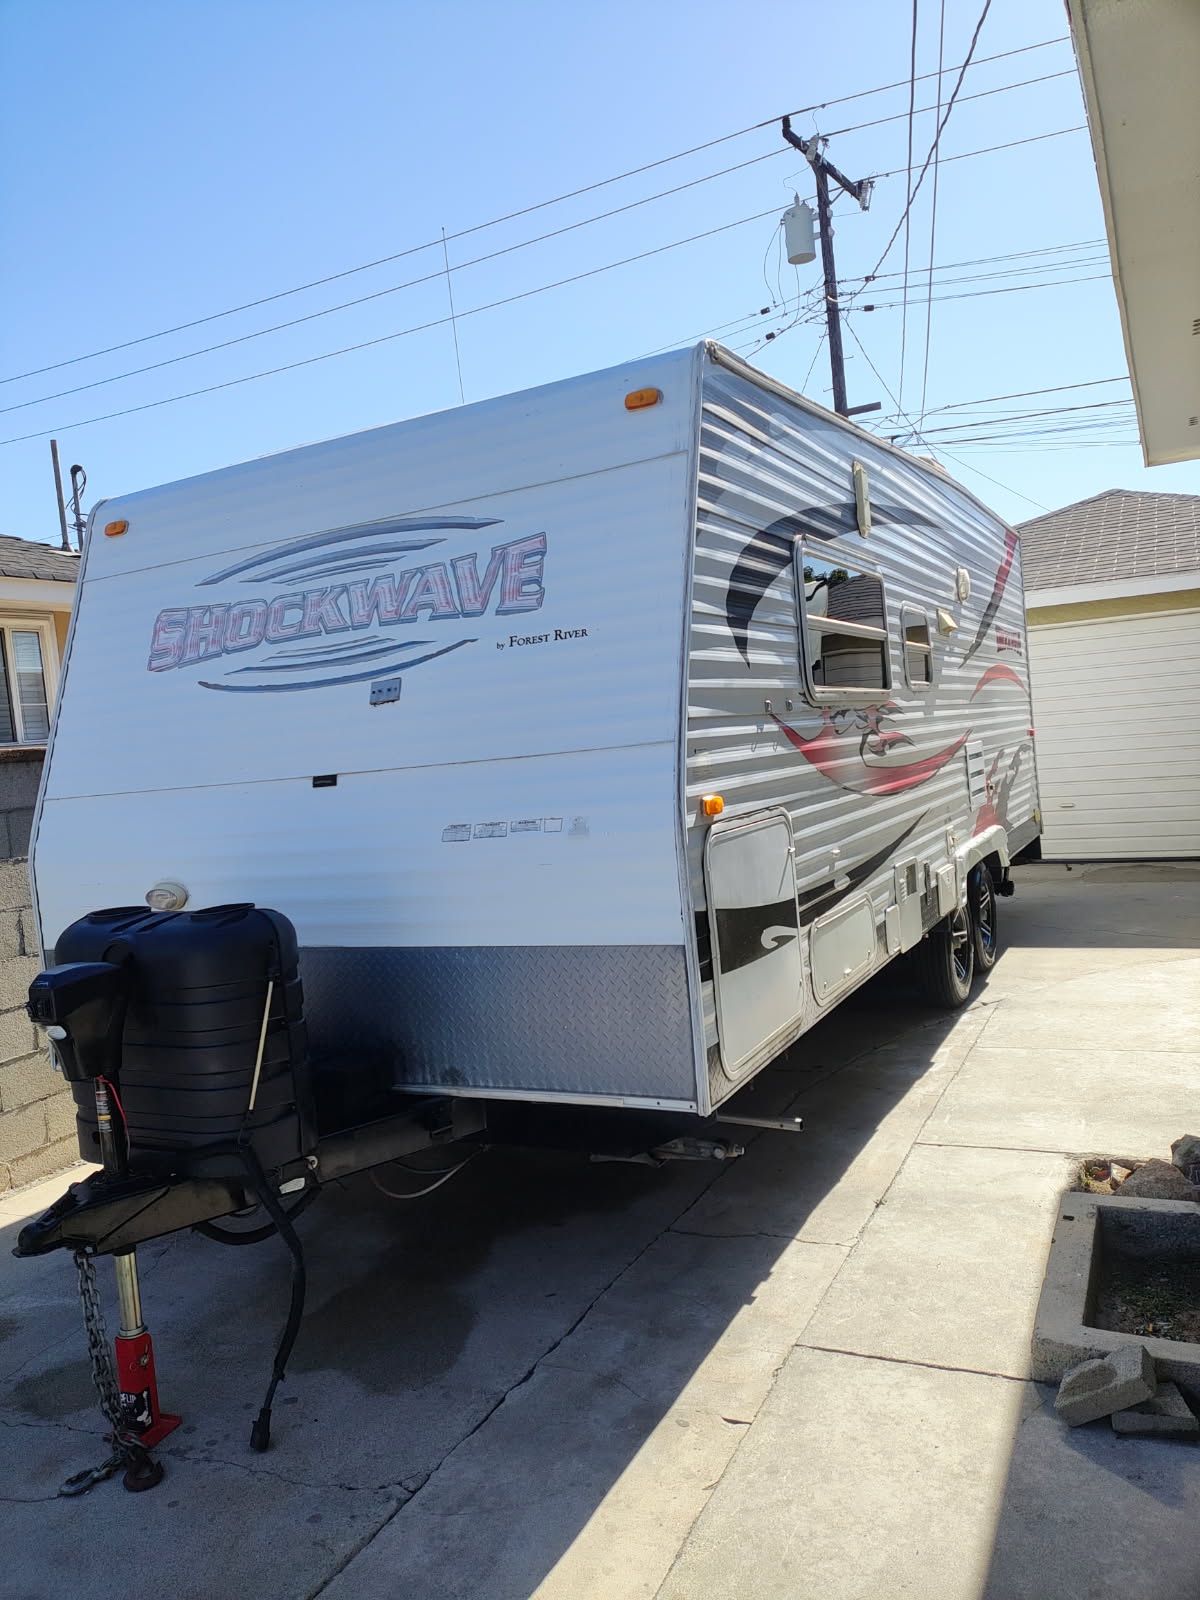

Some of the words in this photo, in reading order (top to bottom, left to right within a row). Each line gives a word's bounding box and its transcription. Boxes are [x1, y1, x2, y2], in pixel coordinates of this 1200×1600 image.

[147, 532, 547, 672] SHOCKWAVE
[496, 642, 505, 650] by
[509, 634, 550, 647] FOREST
[554, 629, 588, 641] RIVER
